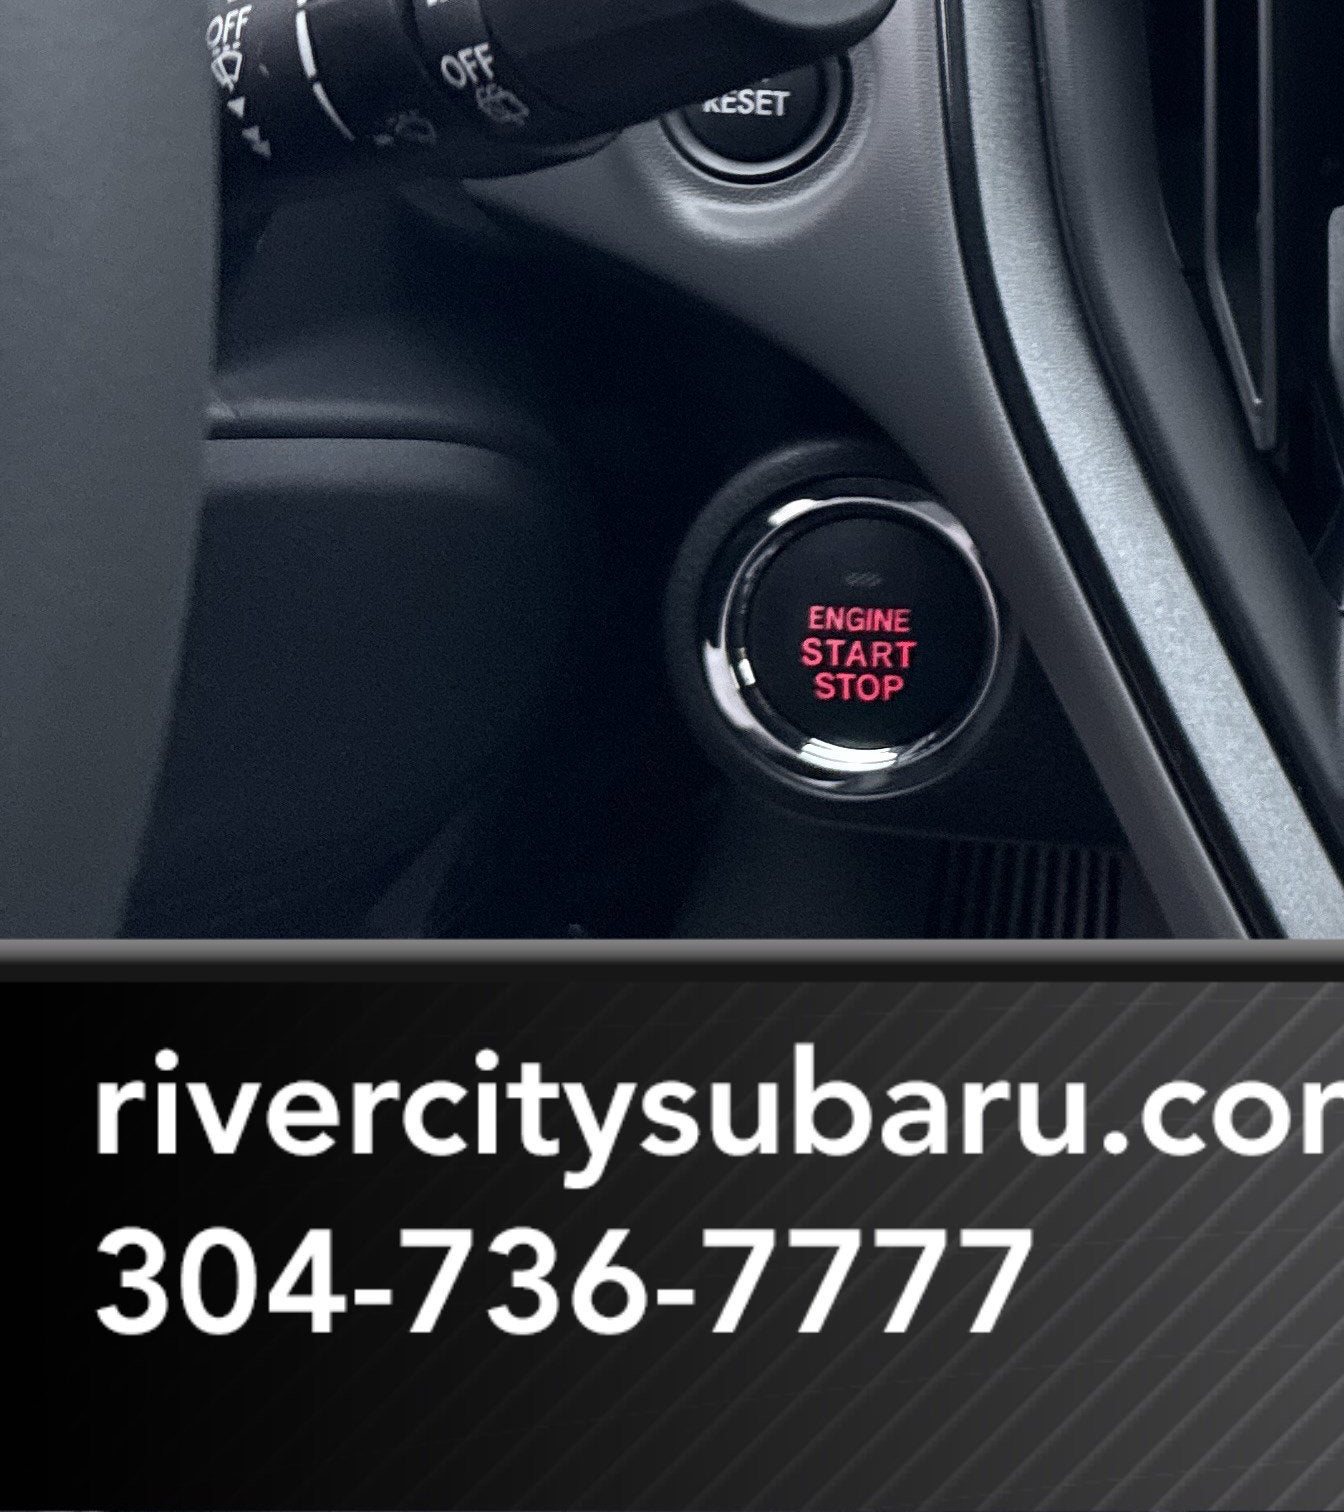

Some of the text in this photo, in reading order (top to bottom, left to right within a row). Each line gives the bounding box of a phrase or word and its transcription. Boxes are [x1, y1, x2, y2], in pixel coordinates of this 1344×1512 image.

[205, 4, 253, 48] OFF
[440, 42, 495, 88] OFF
[808, 605, 912, 633] ENGINE
[801, 638, 917, 668] START
[814, 672, 905, 701] STOP
